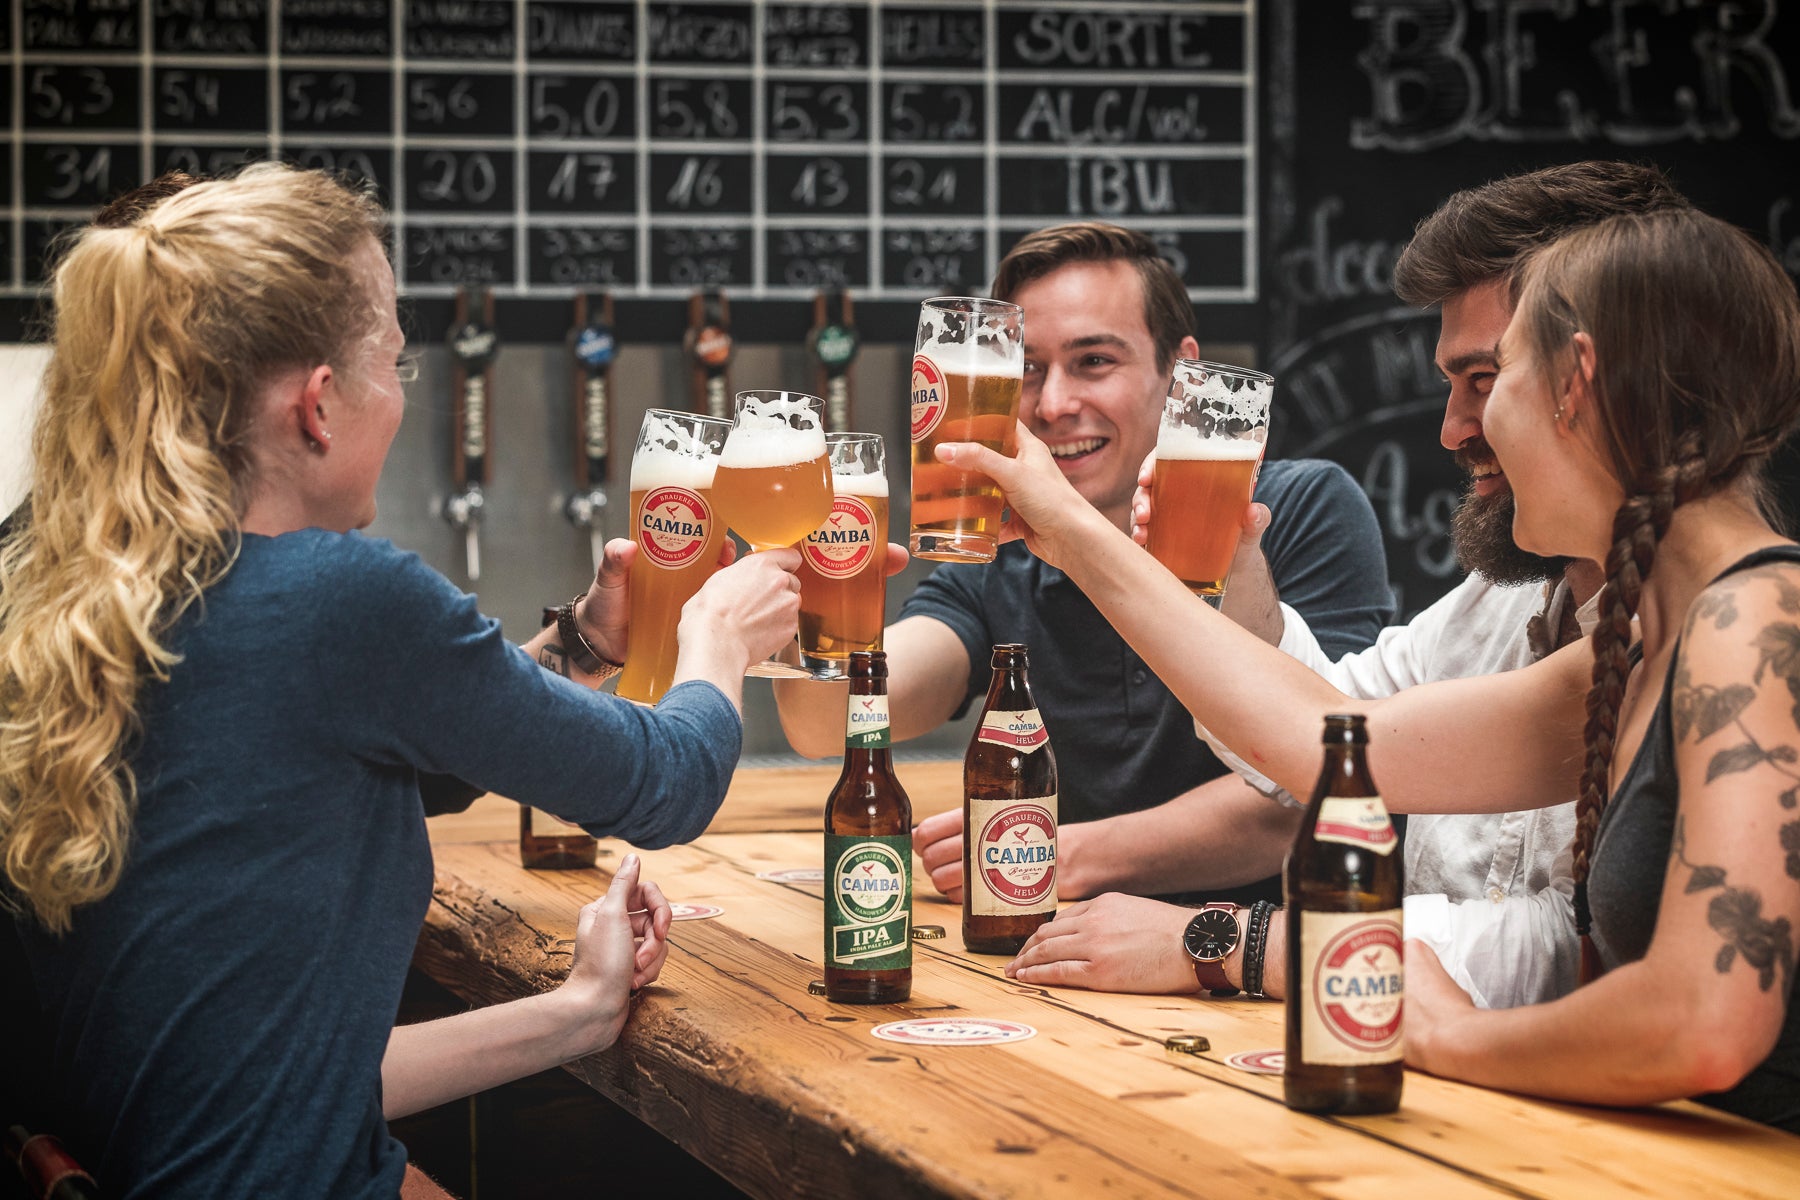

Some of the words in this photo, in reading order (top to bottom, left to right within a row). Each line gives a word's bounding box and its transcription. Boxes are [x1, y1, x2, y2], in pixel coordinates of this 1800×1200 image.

[1012, 10, 1212, 68] SORTE
[1349, 0, 1800, 152] BEER
[31, 66, 114, 125] 5,3
[288, 72, 363, 124] 5,2
[532, 77, 620, 140] 5,0
[656, 80, 739, 138] 5,8
[45, 147, 112, 199] 31
[416, 151, 497, 203] 20
[547, 153, 616, 203] 17
[790, 157, 850, 206] 13
[666, 157, 724, 209] 16
[889, 160, 957, 205] 21
[1066, 153, 1175, 215] IBU
[912, 388, 939, 405] MBA
[660, 494, 695, 507] BRAUEREI
[833, 504, 857, 513] UEREI
[643, 514, 704, 537] CAMBA
[807, 528, 871, 543] CAMBA
[652, 546, 686, 559] HANDWERK
[821, 558, 857, 569] HANDWERK
[851, 712, 888, 722] CAMBA
[1008, 722, 1039, 731] CAMBA
[862, 731, 882, 743] IPA
[1015, 736, 1037, 744] HELL
[1003, 813, 1044, 827] BRAUEREI
[855, 853, 888, 863] BRAUEREI
[985, 844, 1056, 865] CAMBA
[1008, 866, 1043, 875] Bayern
[841, 877, 900, 892] CAMBA
[1013, 887, 1039, 897] HELL
[854, 906, 888, 916] HANDWERK
[853, 926, 891, 947] IPA
[850, 945, 867, 953] INDIA
[867, 942, 882, 950] PALE
